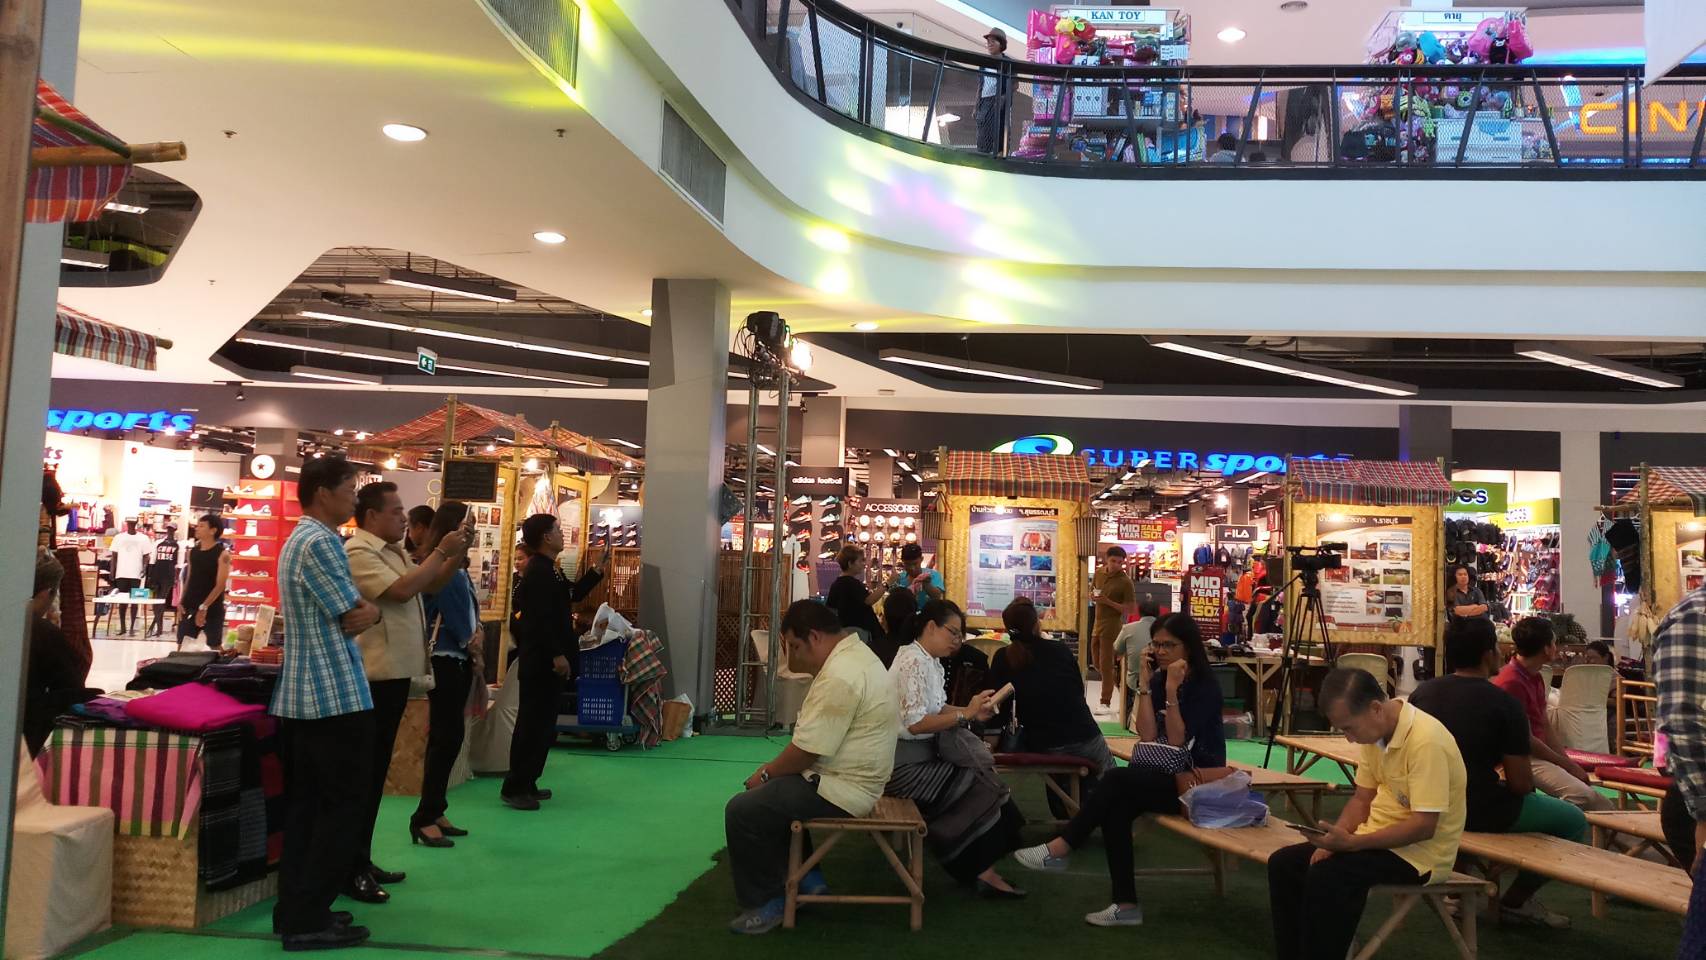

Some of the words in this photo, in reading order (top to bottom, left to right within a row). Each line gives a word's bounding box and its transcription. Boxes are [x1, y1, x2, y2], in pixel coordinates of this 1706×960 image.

[1091, 11, 1114, 20] KAN
[1118, 11, 1141, 20] TOY
[47, 408, 194, 433] sports
[864, 503, 919, 513] ACCESSORIES
[1120, 523, 1140, 532] MID
[1224, 529, 1249, 538] FILA
[1191, 576, 1220, 588] MID
[1191, 589, 1220, 597] YEAR
[1191, 597, 1219, 605] SALE
